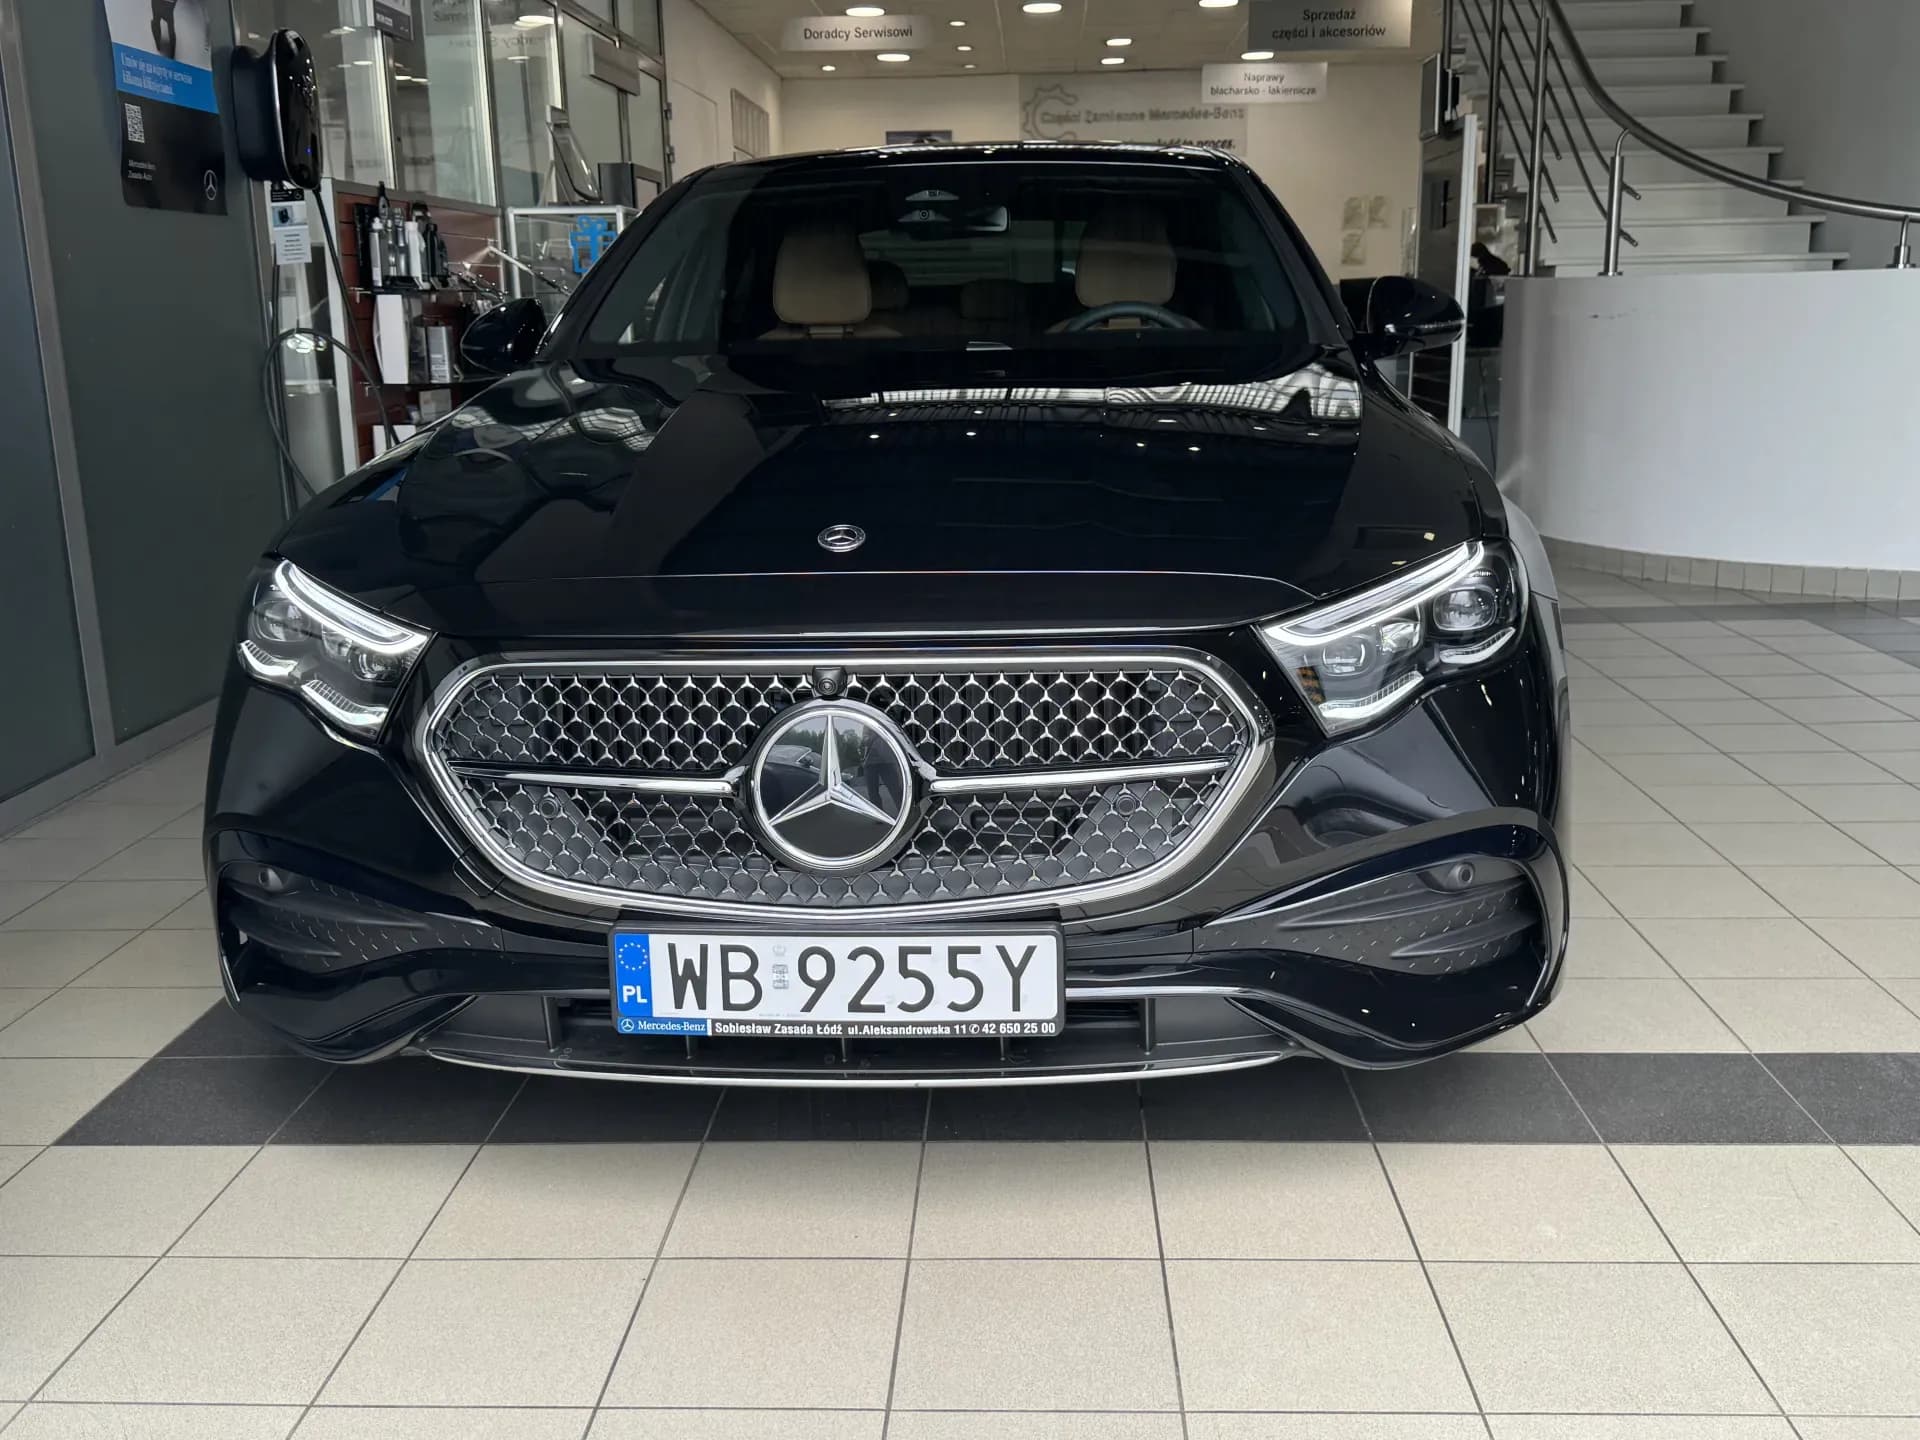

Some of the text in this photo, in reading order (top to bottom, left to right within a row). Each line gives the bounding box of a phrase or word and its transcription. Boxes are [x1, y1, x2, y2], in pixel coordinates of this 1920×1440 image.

[1302, 8, 1356, 23] Sprzedaż
[803, 25, 913, 41] Doradcy Serwisowi
[1272, 25, 1308, 40] części
[1319, 25, 1386, 38] akcesoriów
[1243, 72, 1285, 84] Naprawy
[1210, 86, 1260, 96] blacharsko
[1268, 86, 1317, 96] lakiernicza
[1148, 106, 1245, 122] Mercedes-Benz
[667, 942, 1038, 1014] WB 9255Y
[623, 985, 648, 1004] PL
[638, 1021, 706, 1032] Mercedes-Benz
[715, 1022, 771, 1034] Sobiesław
[774, 1023, 814, 1035] Zasada
[816, 1022, 843, 1035] Łódź
[953, 1023, 967, 1035] 11
[982, 1023, 997, 1034] 42
[999, 1022, 1021, 1034] 650
[1023, 1022, 1039, 1034] 25
[1041, 1022, 1056, 1034] 00
